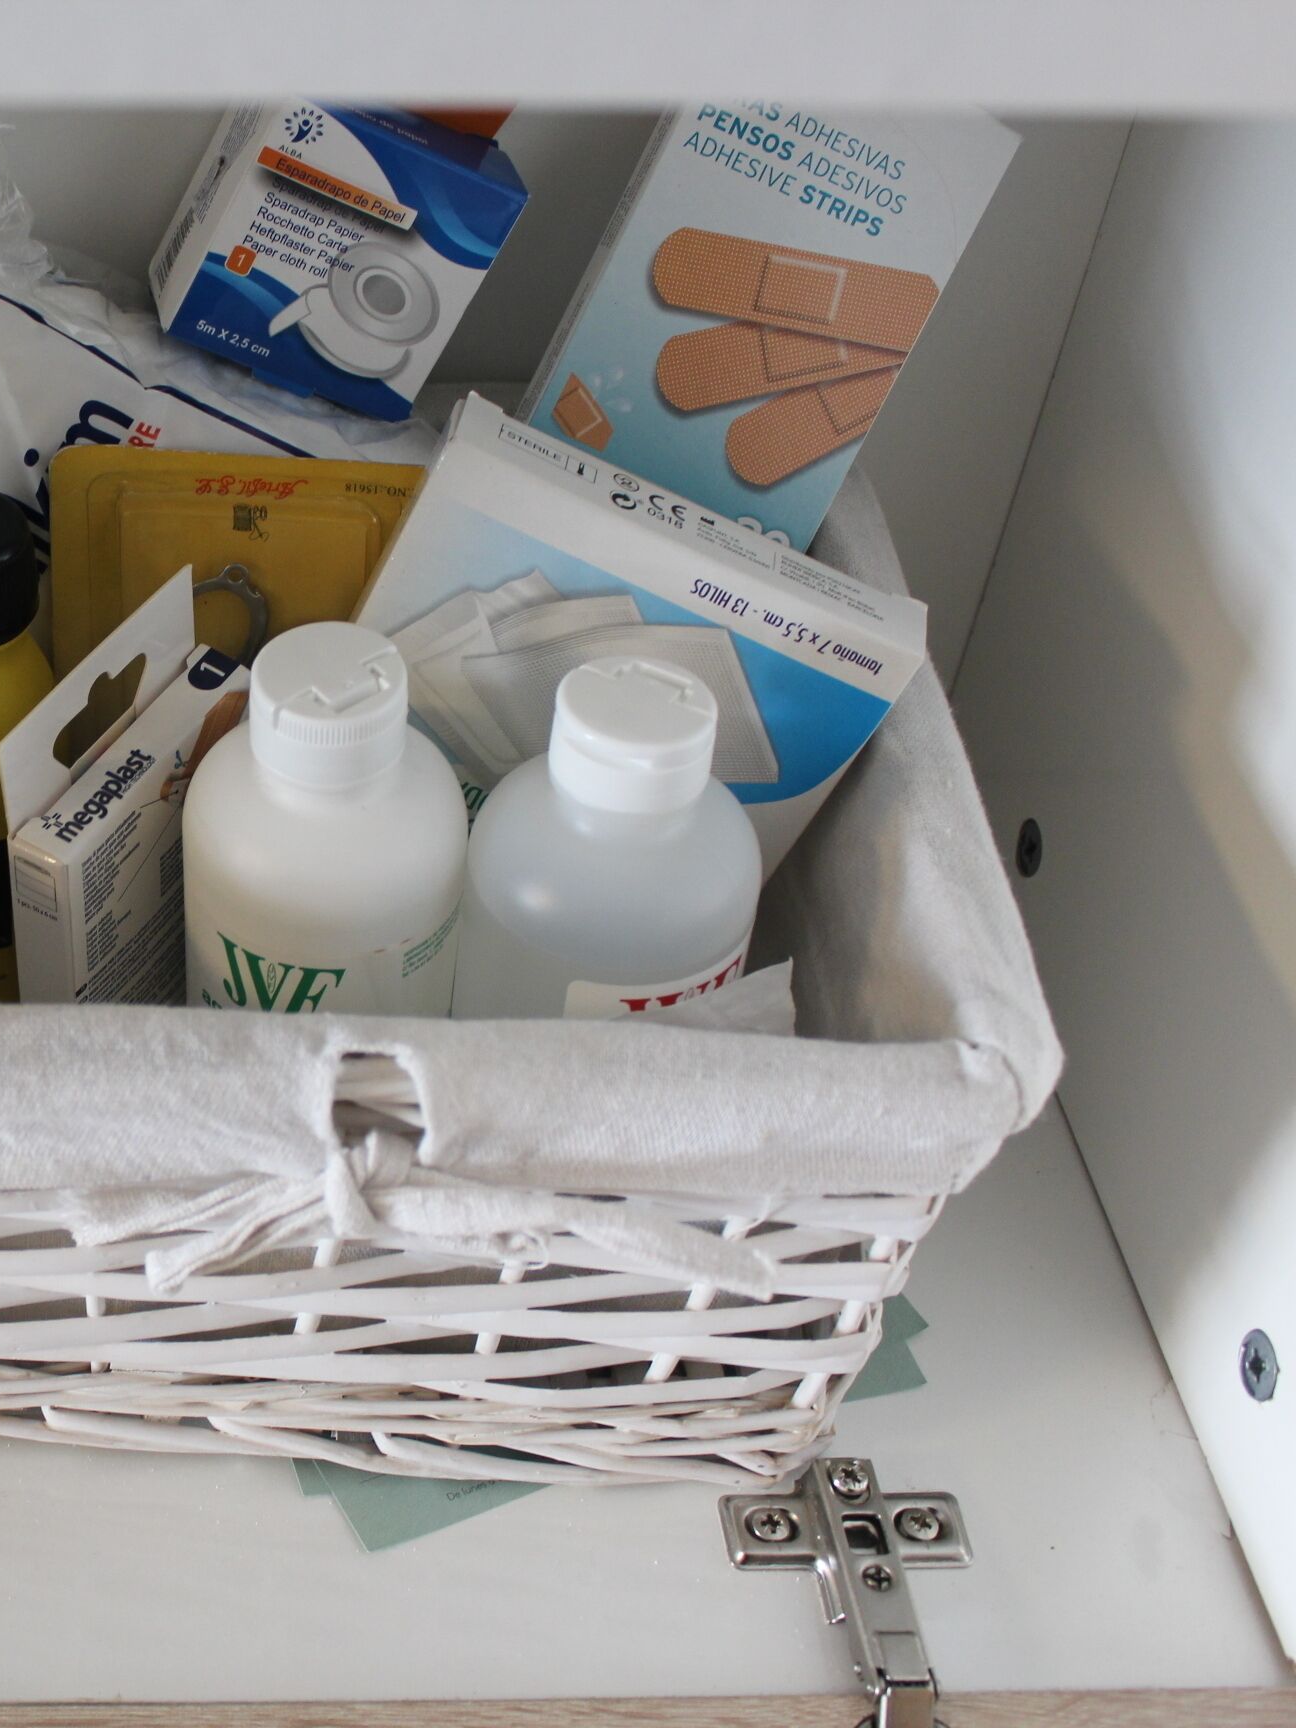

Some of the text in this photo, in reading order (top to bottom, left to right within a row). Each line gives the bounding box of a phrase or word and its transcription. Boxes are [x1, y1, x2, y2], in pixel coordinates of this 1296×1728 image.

[278, 144, 303, 159] ALBA
[697, 103, 907, 214] PENSOS ADESIVOS
[785, 112, 906, 180] ADHESIVAS
[275, 157, 406, 224] Esparadrapo de Papel
[683, 131, 884, 237] ADHESIVE STRIPS
[257, 206, 349, 253] Rocchetto Carta
[264, 191, 365, 242] Sparadrap Papier
[236, 254, 245, 268] 1
[242, 234, 328, 279] Paper cloth roll
[249, 220, 355, 273] Heftpflaster Papier
[196, 319, 271, 358] 5m X 2,5 cm
[505, 430, 563, 462] STERILE
[690, 578, 732, 608] HILOS
[731, 598, 750, 617] 13
[763, 608, 784, 628] cm.
[781, 622, 808, 643] 5,5
[809, 631, 821, 645] x
[817, 639, 832, 654] 7
[832, 643, 883, 675] tamaño
[55, 749, 152, 843] megaplast
